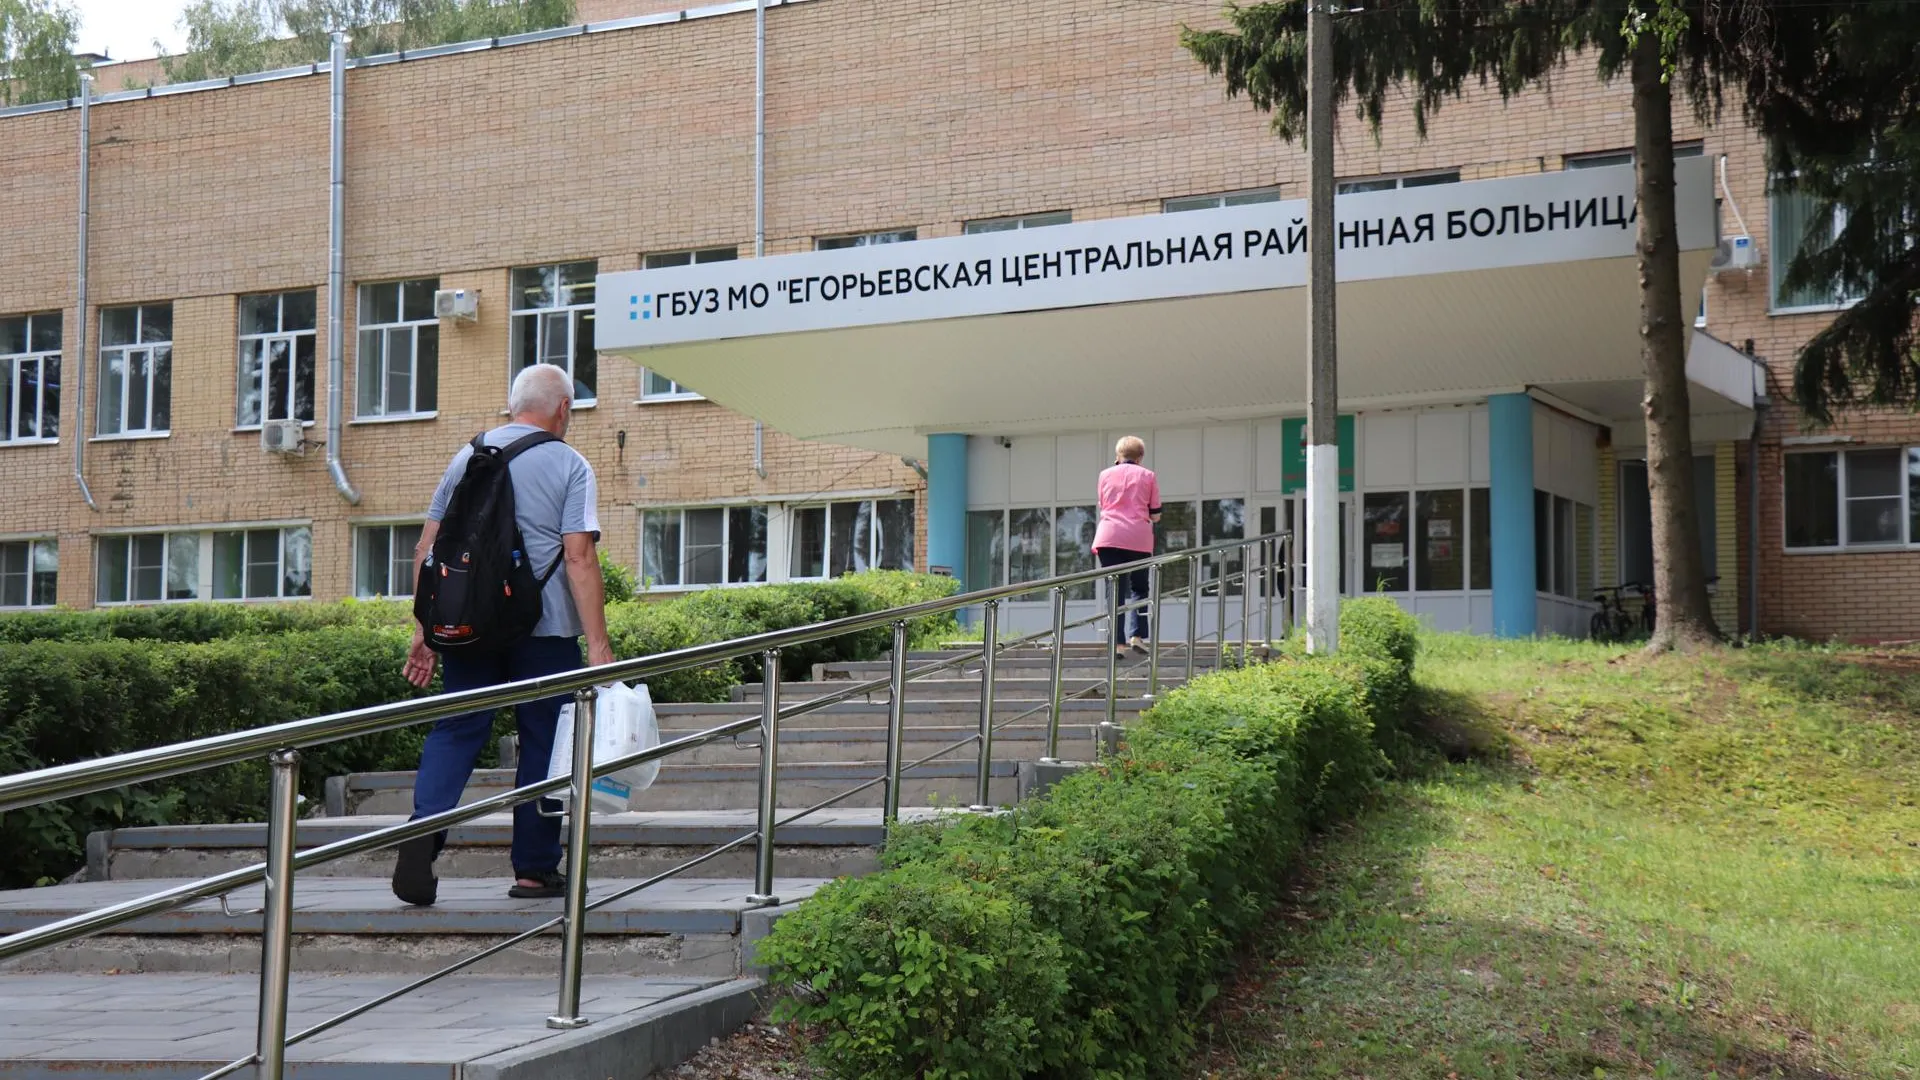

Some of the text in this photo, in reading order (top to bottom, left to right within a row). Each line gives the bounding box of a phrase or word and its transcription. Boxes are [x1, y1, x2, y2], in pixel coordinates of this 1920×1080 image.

[656, 288, 720, 319] ГБУЗ
[728, 282, 770, 311] МО
[777, 259, 992, 305] "ЕГОРЬЕВСКАЯ
[1002, 232, 1233, 287] ЦЕНТРАЛЬНАЯ
[1244, 212, 1435, 258] РАЙННАЯ
